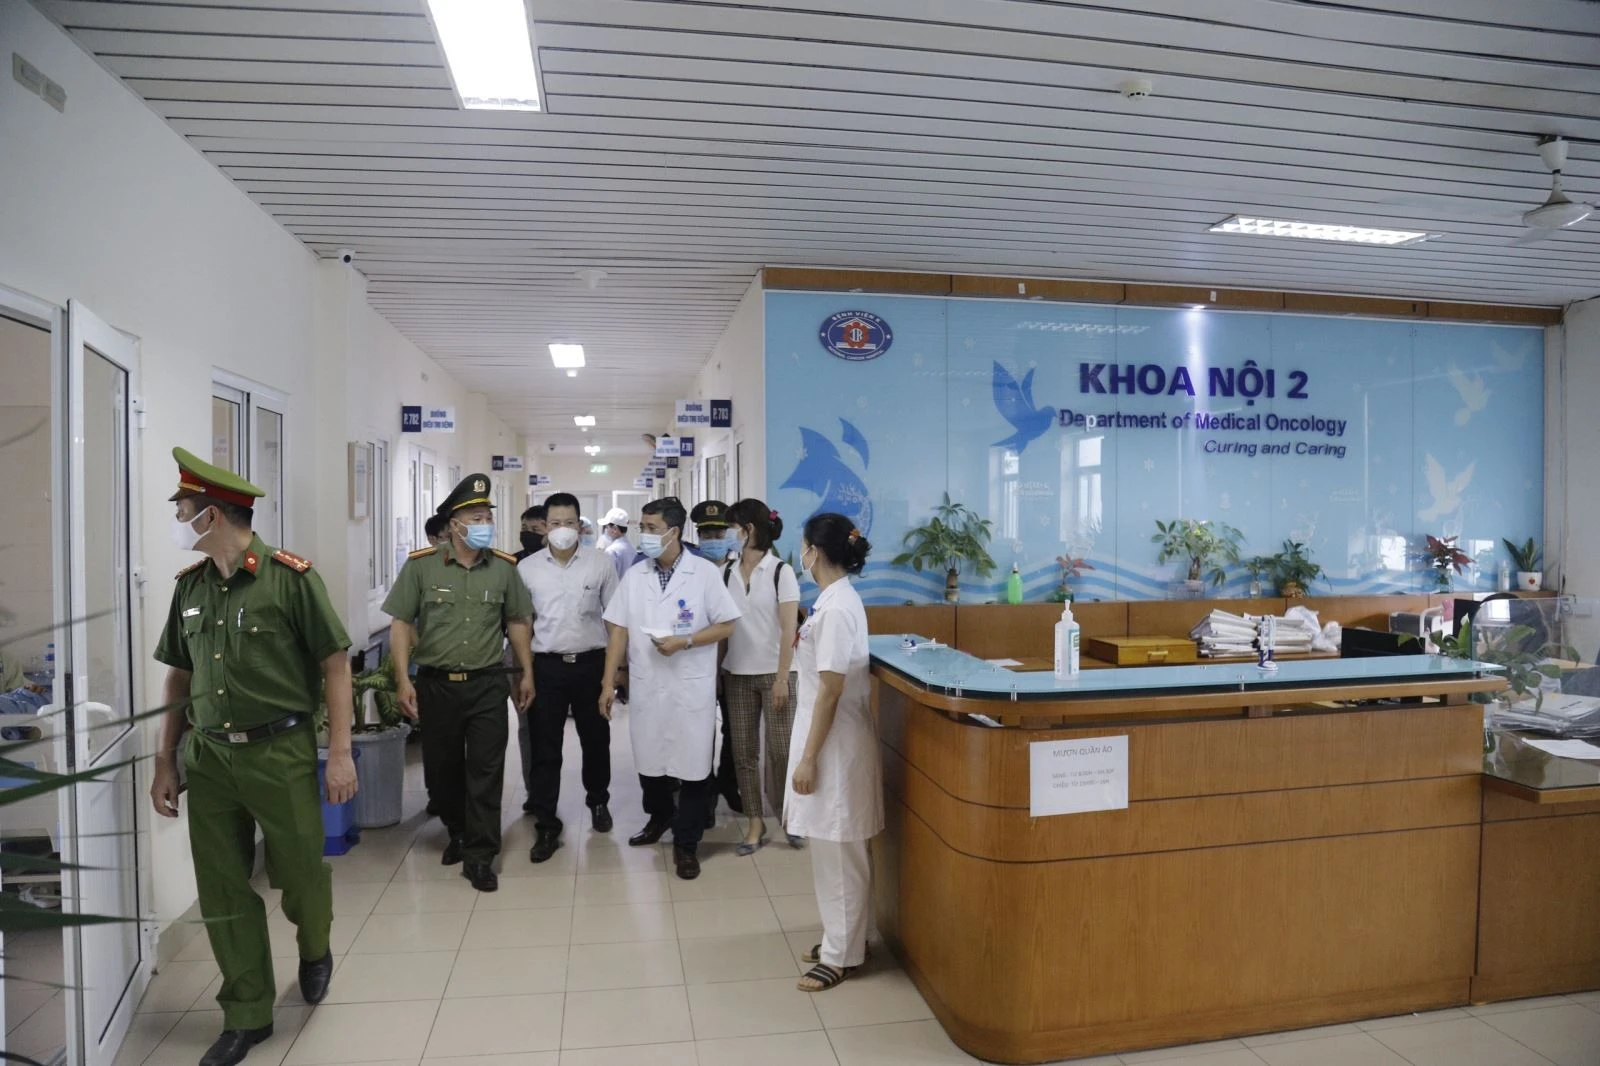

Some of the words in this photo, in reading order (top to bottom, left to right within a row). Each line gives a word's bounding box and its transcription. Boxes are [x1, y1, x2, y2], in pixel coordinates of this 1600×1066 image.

[1079, 362, 1196, 397] KHOA
[1208, 359, 1275, 406] NỘI
[1287, 370, 1309, 399] 2
[1059, 408, 1168, 432] Department
[1172, 411, 1192, 429] of
[1195, 412, 1261, 431] Medical
[1265, 413, 1348, 437] Oncology
[1204, 439, 1258, 457] Curing
[1261, 441, 1290, 455] and
[1295, 442, 1347, 459] Caring
